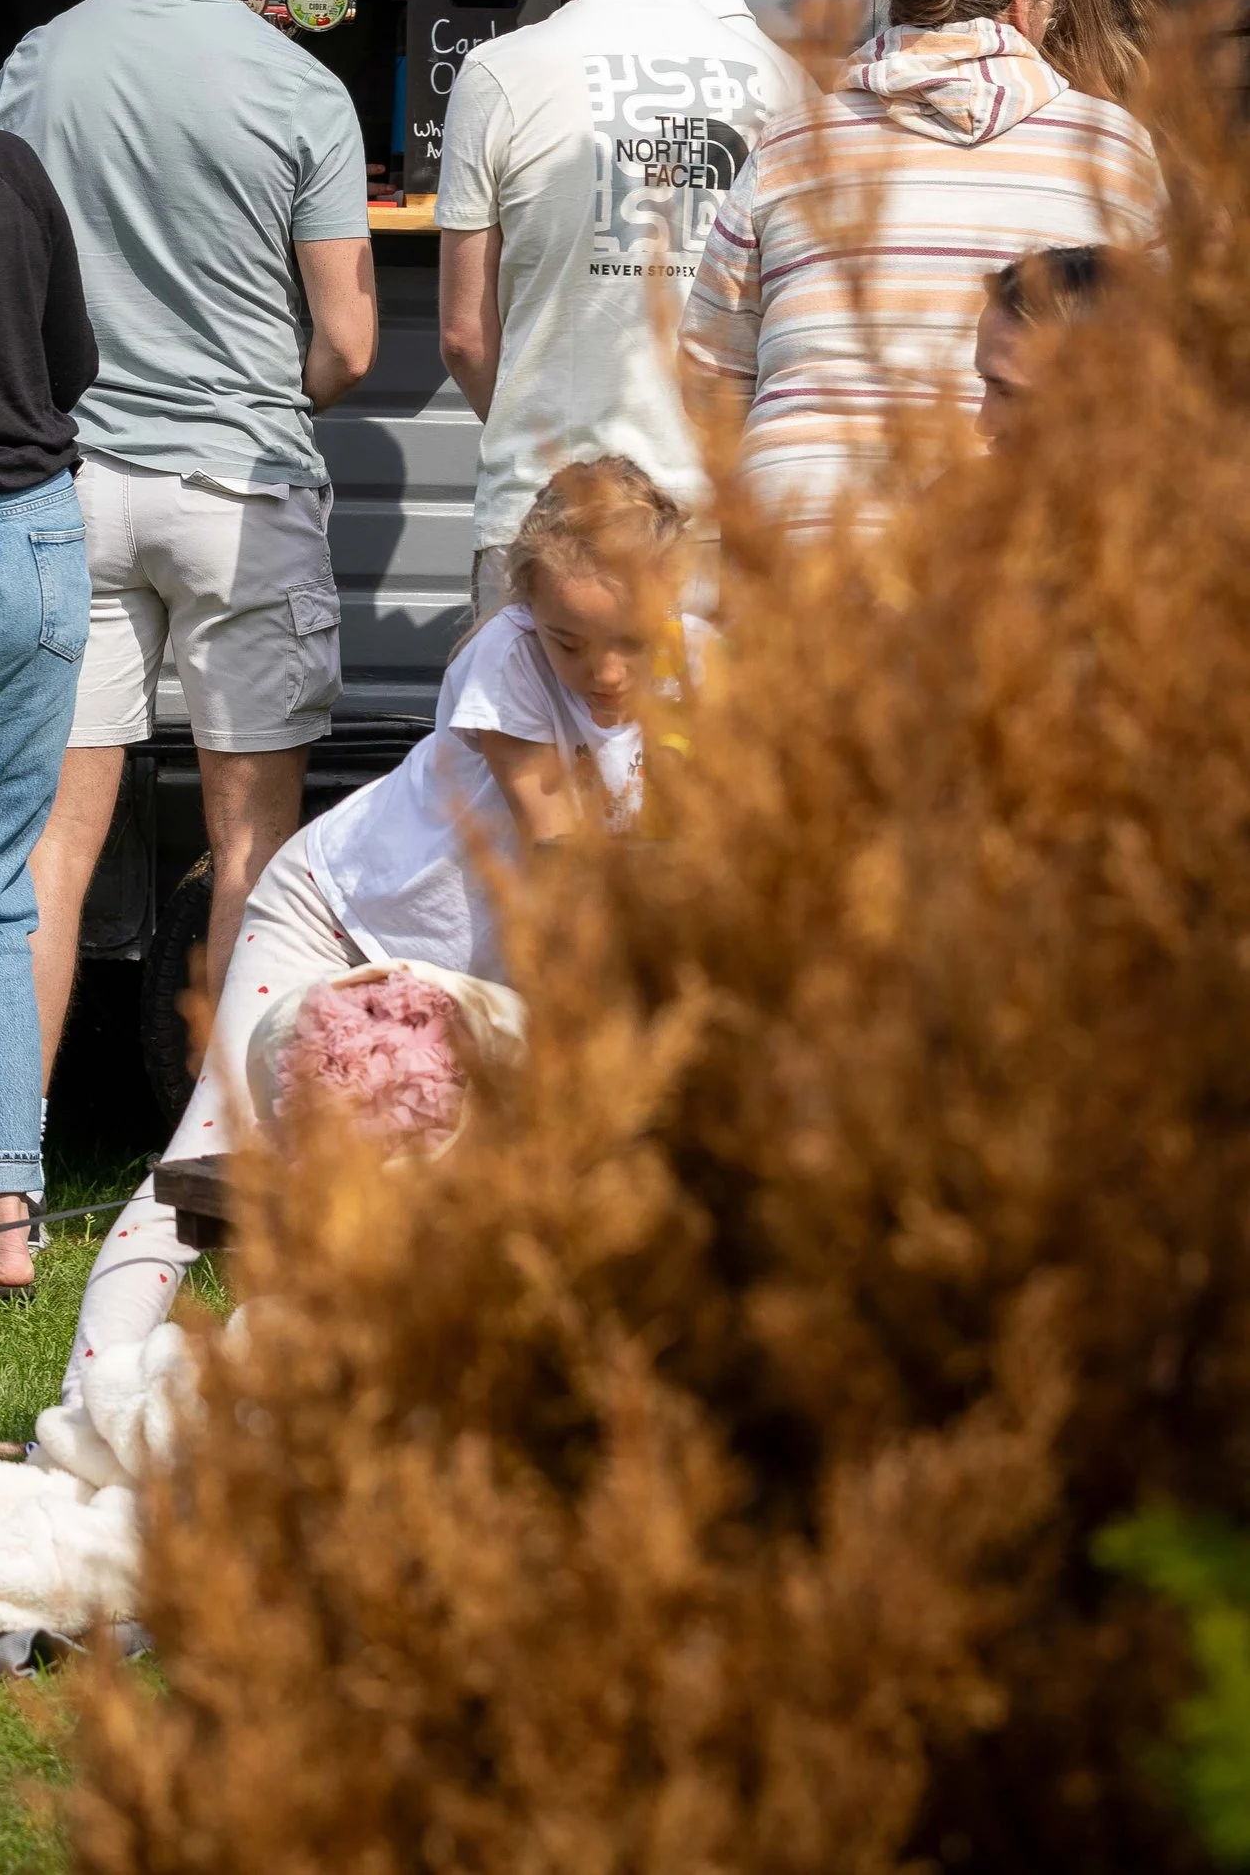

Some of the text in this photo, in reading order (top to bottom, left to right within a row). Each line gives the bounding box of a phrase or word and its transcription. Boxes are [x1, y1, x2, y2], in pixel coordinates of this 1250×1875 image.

[308, 3, 328, 11] CIDER
[654, 115, 705, 140] THE
[616, 139, 705, 164] NORTH
[644, 164, 705, 189] FACE
[589, 264, 642, 276] NEVER
